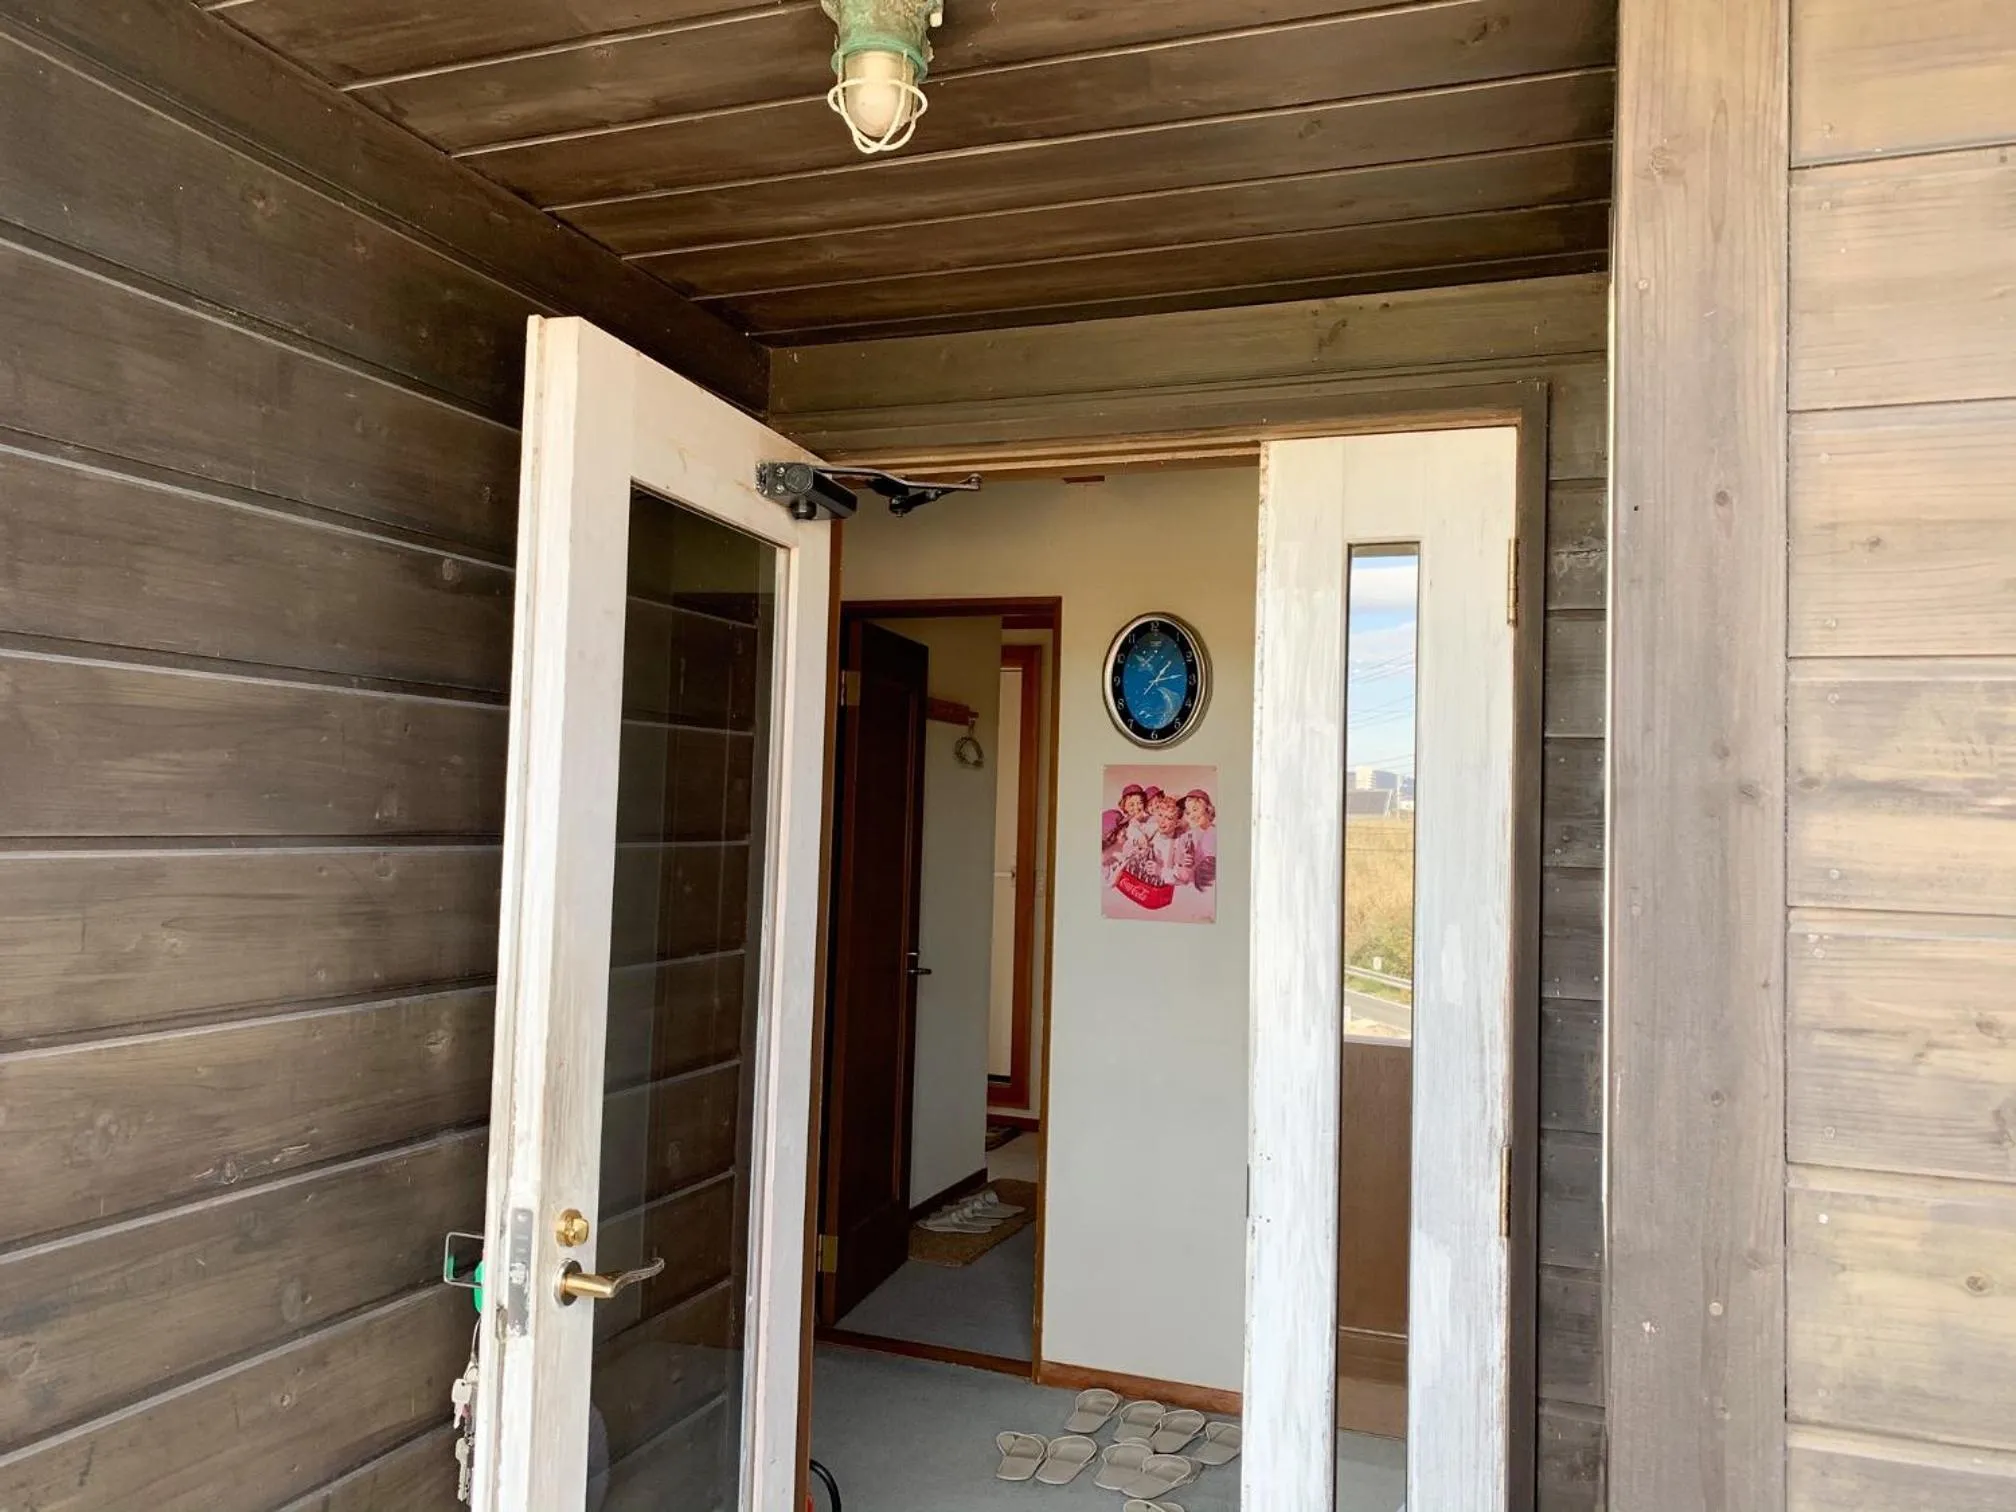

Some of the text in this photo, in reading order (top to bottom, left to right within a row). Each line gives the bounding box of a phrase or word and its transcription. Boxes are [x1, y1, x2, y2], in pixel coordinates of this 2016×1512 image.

[1150, 622, 1160, 631] 12
[1128, 633, 1135, 643] 11
[1185, 652, 1193, 663] 2
[1113, 676, 1121, 686] 9
[1189, 675, 1197, 685] 3
[1117, 698, 1125, 709] 8
[1185, 698, 1192, 709] 4
[1127, 718, 1134, 729] 7
[1174, 718, 1182, 729] 5
[1151, 730, 1159, 740] 6
